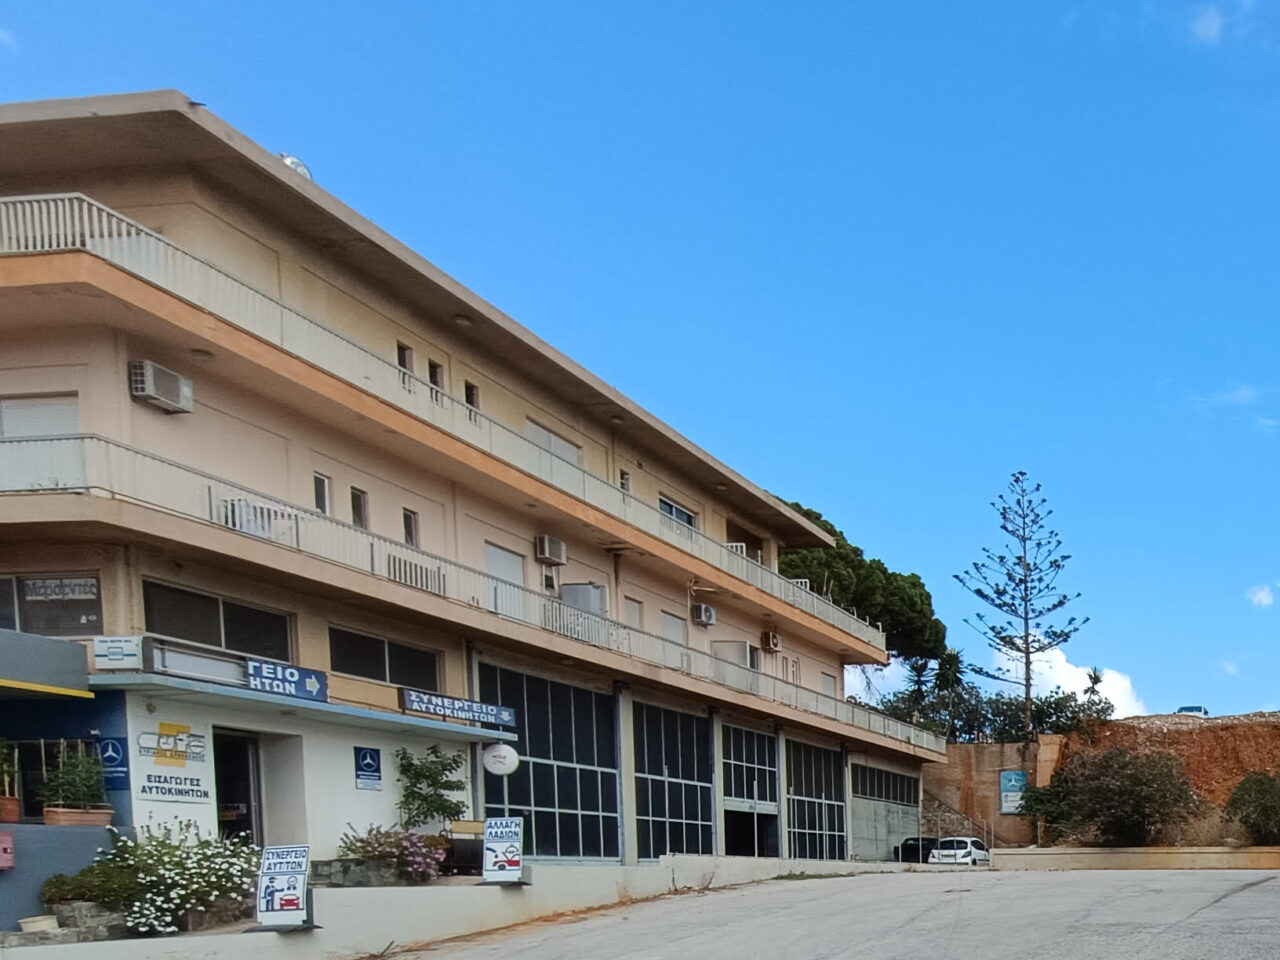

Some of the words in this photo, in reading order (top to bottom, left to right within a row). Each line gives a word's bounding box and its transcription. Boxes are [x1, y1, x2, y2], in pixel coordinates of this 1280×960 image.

[247, 661, 299, 682] ΓΕΙΟ
[249, 676, 296, 695] ΗΤΩΝ
[409, 690, 497, 715] ΣΥΝΕΡΓΕΙΟ
[412, 702, 496, 723] ΑΥΤΟΚΙΝΗΤΩΝ
[146, 774, 202, 787] ΕΙΣΑΓΩΓΕΣ
[141, 785, 209, 799] ΑΥΤΟΚΙΝΗΤΩΝ
[487, 821, 521, 830] ΑΛΛΑΓΗ
[488, 830, 519, 839] ΛΑΔΙΩΝ
[265, 849, 306, 861] ΣΥΝΕΡΓΕΙΟ
